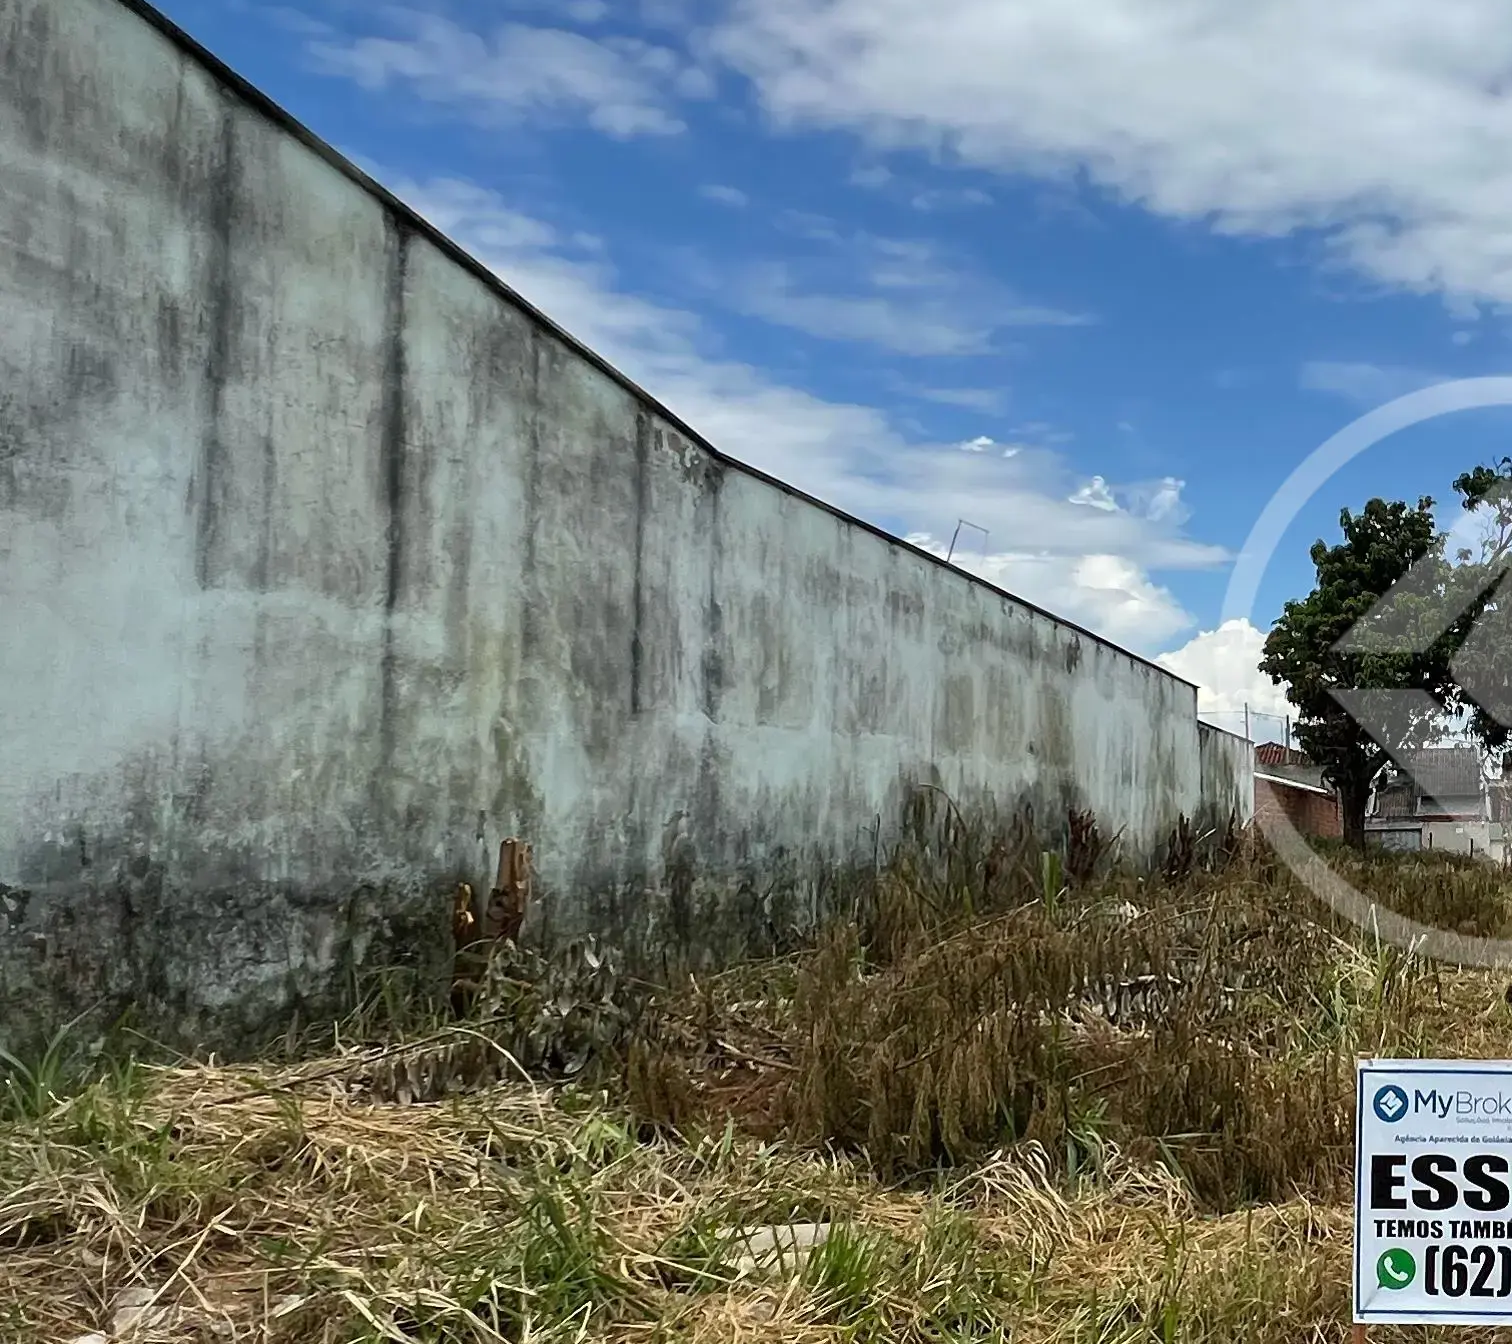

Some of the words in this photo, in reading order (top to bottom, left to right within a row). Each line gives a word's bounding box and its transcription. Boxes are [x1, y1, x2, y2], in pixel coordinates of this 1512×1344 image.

[1428, 1135, 1469, 1144] Aparecida
[1374, 1219, 1443, 1239] TEMOS
[1424, 1245, 1512, 1298] (62)
